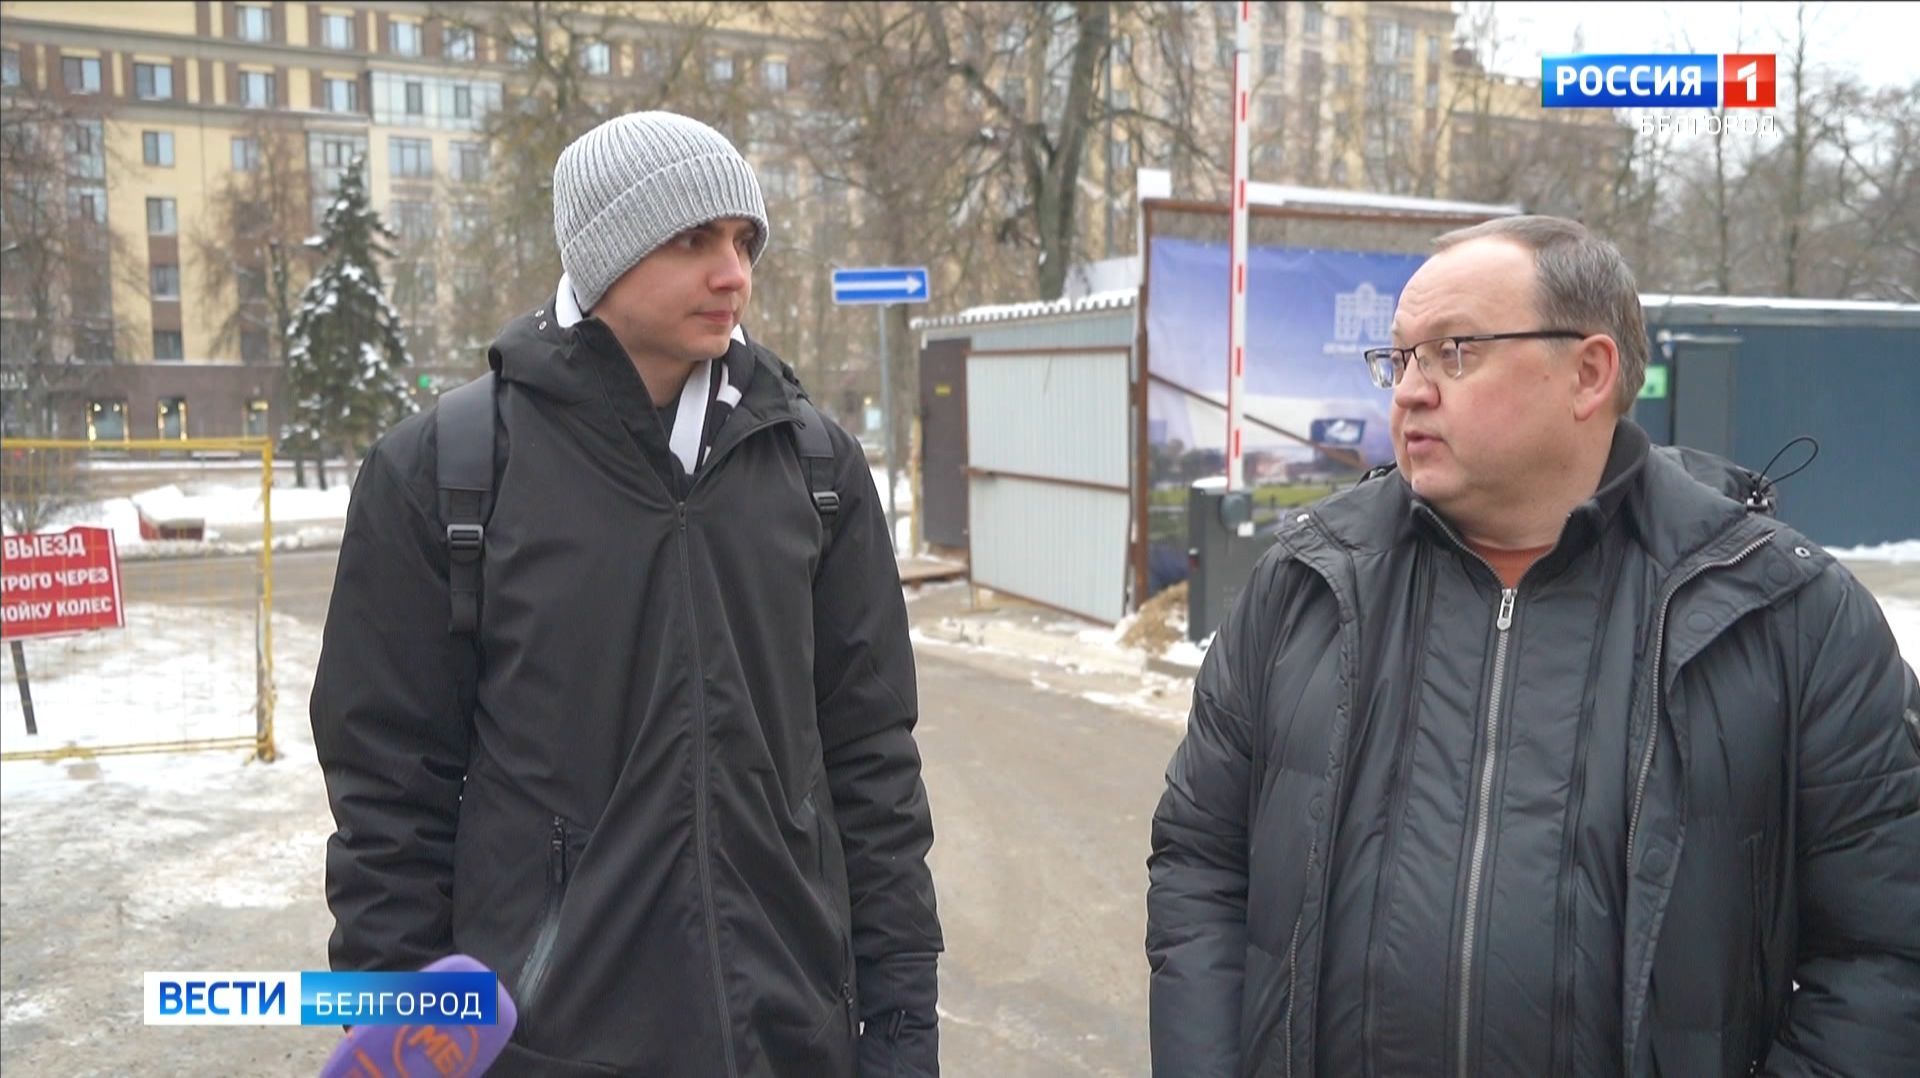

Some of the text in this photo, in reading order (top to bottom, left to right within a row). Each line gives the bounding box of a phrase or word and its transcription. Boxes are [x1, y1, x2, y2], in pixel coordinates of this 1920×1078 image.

[4, 533, 86, 560] ВЫЕЗД
[55, 566, 110, 587] ЧЕРЕЗ
[56, 596, 113, 617] КОЛЕС
